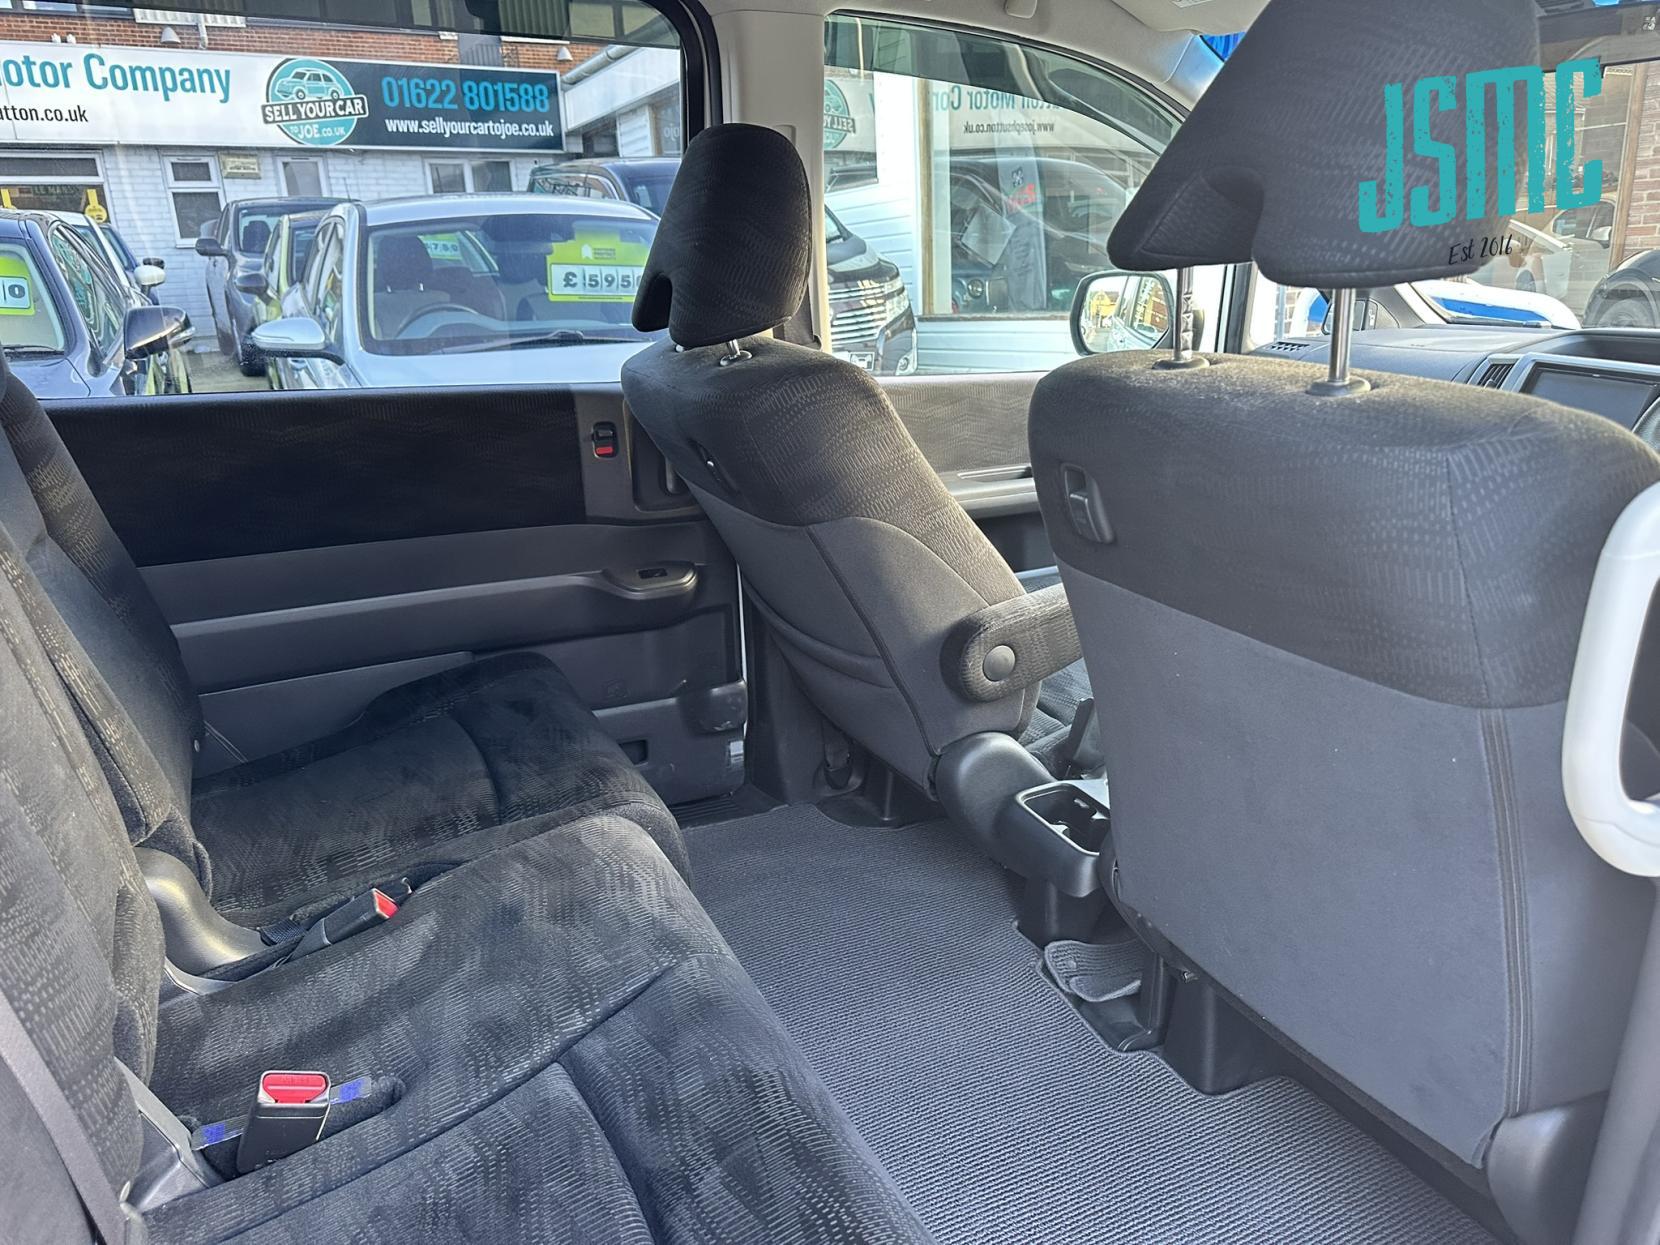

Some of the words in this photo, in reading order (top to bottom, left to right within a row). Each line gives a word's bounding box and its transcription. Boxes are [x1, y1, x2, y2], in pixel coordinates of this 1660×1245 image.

[0, 55, 72, 89] otor
[83, 53, 231, 104] Company
[381, 76, 458, 110] 01622
[462, 80, 550, 113] 801588
[265, 104, 297, 122] SELL
[297, 101, 335, 119] YOUR
[335, 98, 364, 116] CAR
[384, 117, 554, 139] www.sellyourcartojoe.co.uk
